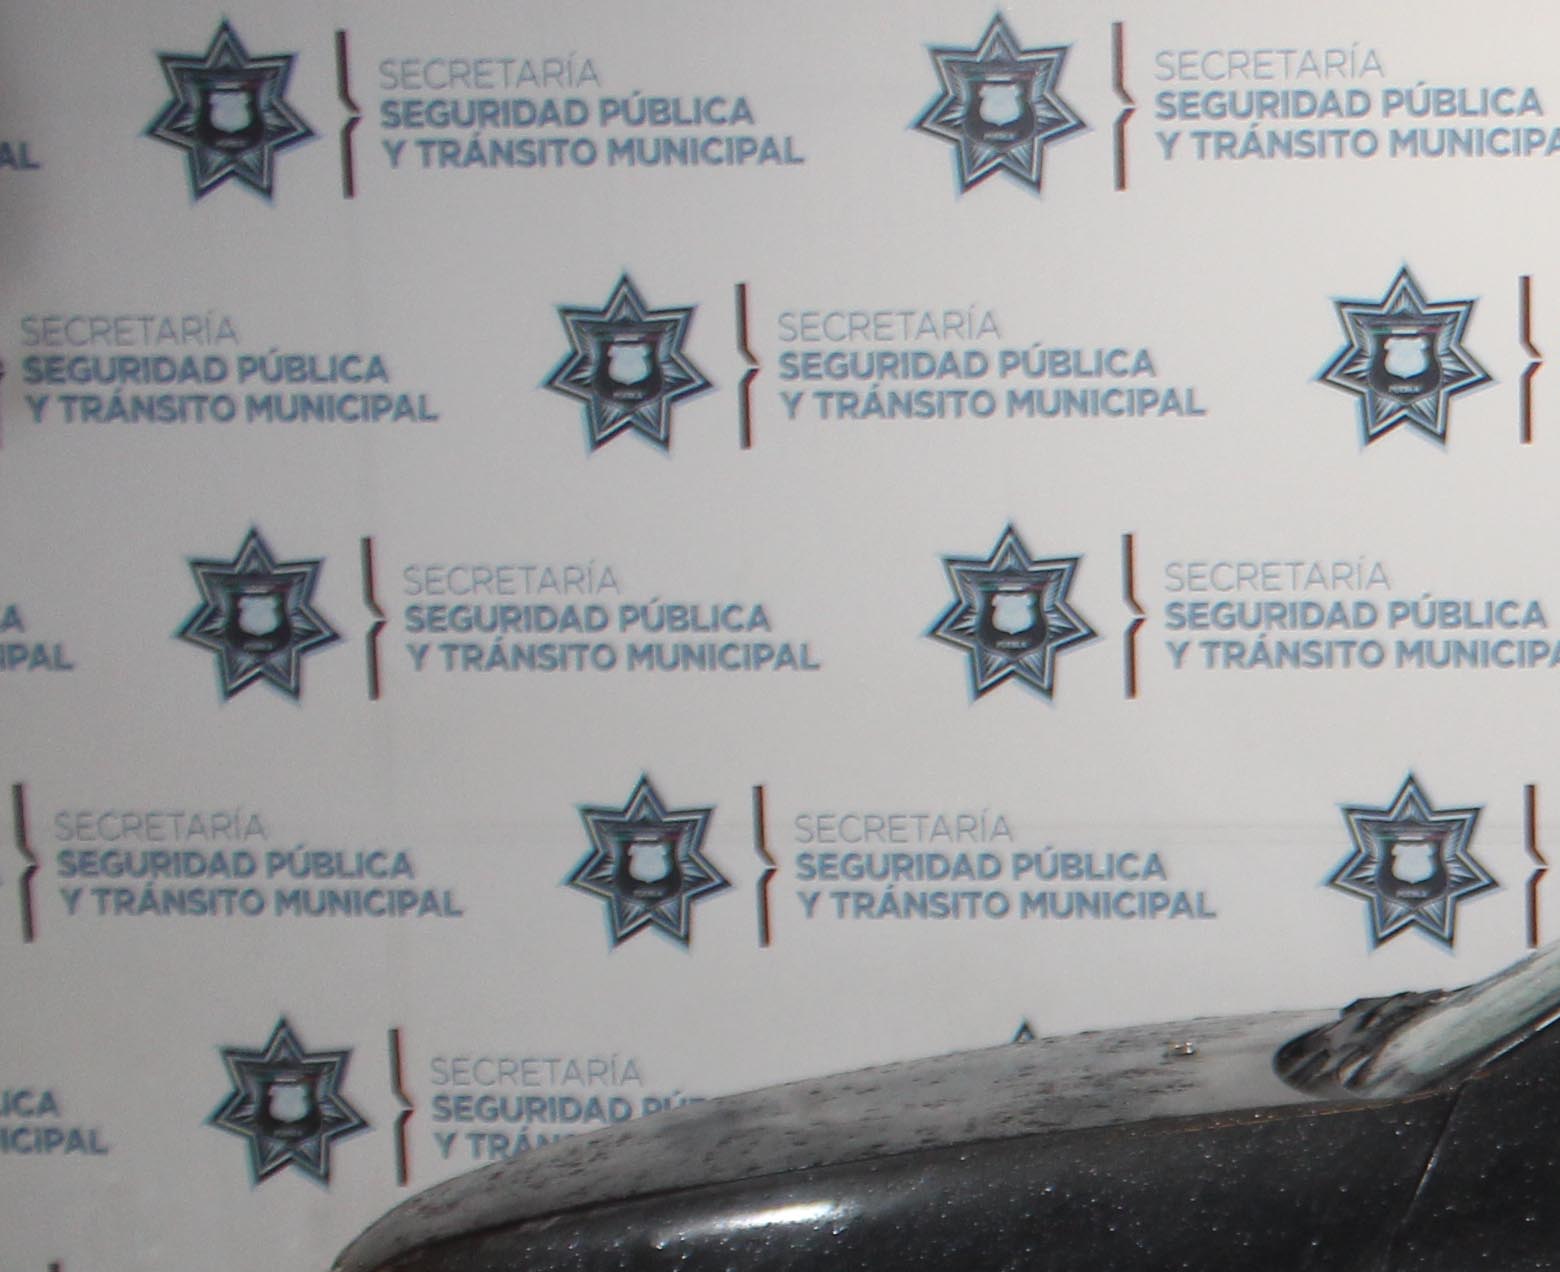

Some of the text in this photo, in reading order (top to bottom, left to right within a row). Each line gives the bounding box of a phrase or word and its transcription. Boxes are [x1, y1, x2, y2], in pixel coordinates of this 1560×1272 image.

[379, 51, 601, 90] SECRETARÍA
[1154, 41, 1385, 81] SECRETARÍA
[381, 89, 755, 129] SEGURIDAD PÚBLICA
[1155, 79, 1544, 120] SEGURIDAD PÚBLICA
[382, 131, 805, 168] Y TRÁNSITO MUNICIPAL
[1155, 130, 1181, 160] Y
[1189, 121, 1379, 160] TRÁNSITO
[21, 310, 239, 346] SECRETARÍA
[778, 304, 1002, 342] SECRETARÍA
[23, 347, 389, 384] SEGURIDAD PÚBLICA
[779, 341, 1156, 381] SEGURIDAD PÚBLICA
[25, 388, 439, 423] Y TRÁNSITO MUNICIPAL
[779, 383, 1207, 419] Y TRÁNSITO MUNICIPAL
[403, 559, 621, 596] SECRETARÍA
[1164, 555, 1391, 592] SECRETARÍA
[405, 597, 772, 633] SEGURIDAD PÚBLICA
[1165, 592, 1548, 630] SEGURIDAD PÚBLICA
[406, 636, 821, 671] Y TRÁNSITO MUNICIPAL
[1165, 640, 1191, 669] Y
[1198, 632, 1385, 669] TRÁNSITO
[55, 809, 268, 842] SECRETARÍA
[794, 808, 1014, 843] SECRETARÍA
[57, 842, 414, 879] SEGURIDAD PÚBLICA
[796, 845, 1167, 881] SEGURIDAD PÚBLICA
[60, 881, 463, 917] Y TRÁNSITO MUNICIPAL
[797, 884, 1217, 919] Y TRÁNSITO MUNICIPAL
[430, 1053, 643, 1087] SECRETARÍA
[432, 1094, 633, 1124] SEGURIDAD
[433, 1132, 456, 1160] Y
